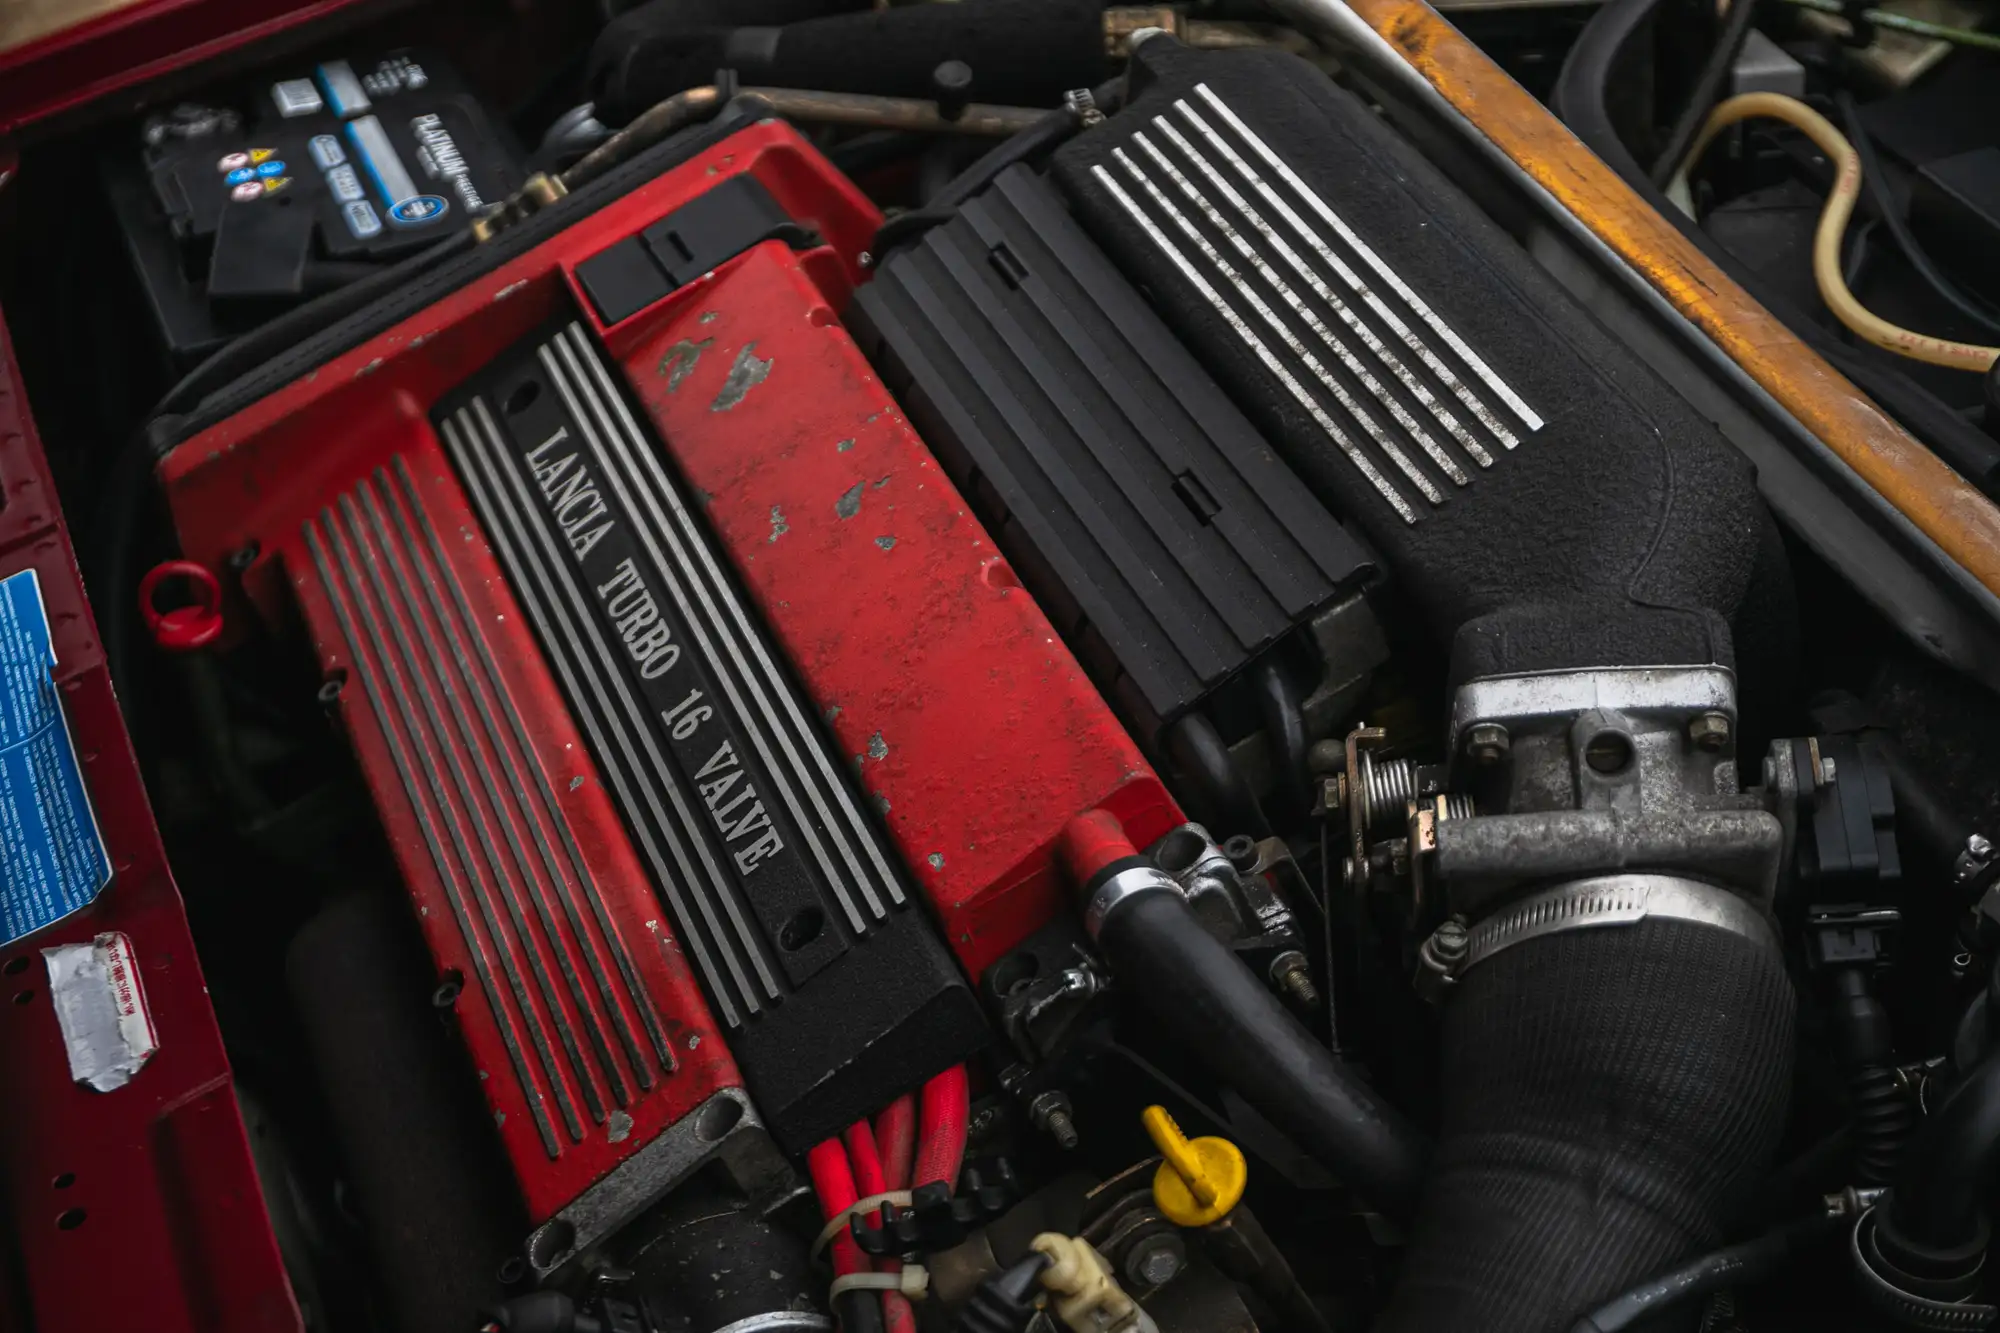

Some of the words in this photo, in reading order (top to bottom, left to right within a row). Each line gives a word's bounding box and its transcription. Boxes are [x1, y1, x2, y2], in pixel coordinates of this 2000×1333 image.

[411, 113, 469, 178] PLATINUM
[526, 426, 616, 561] LANCIA
[597, 556, 682, 680] TURBO
[661, 688, 713, 741] 16
[694, 739, 785, 877] VALVE
